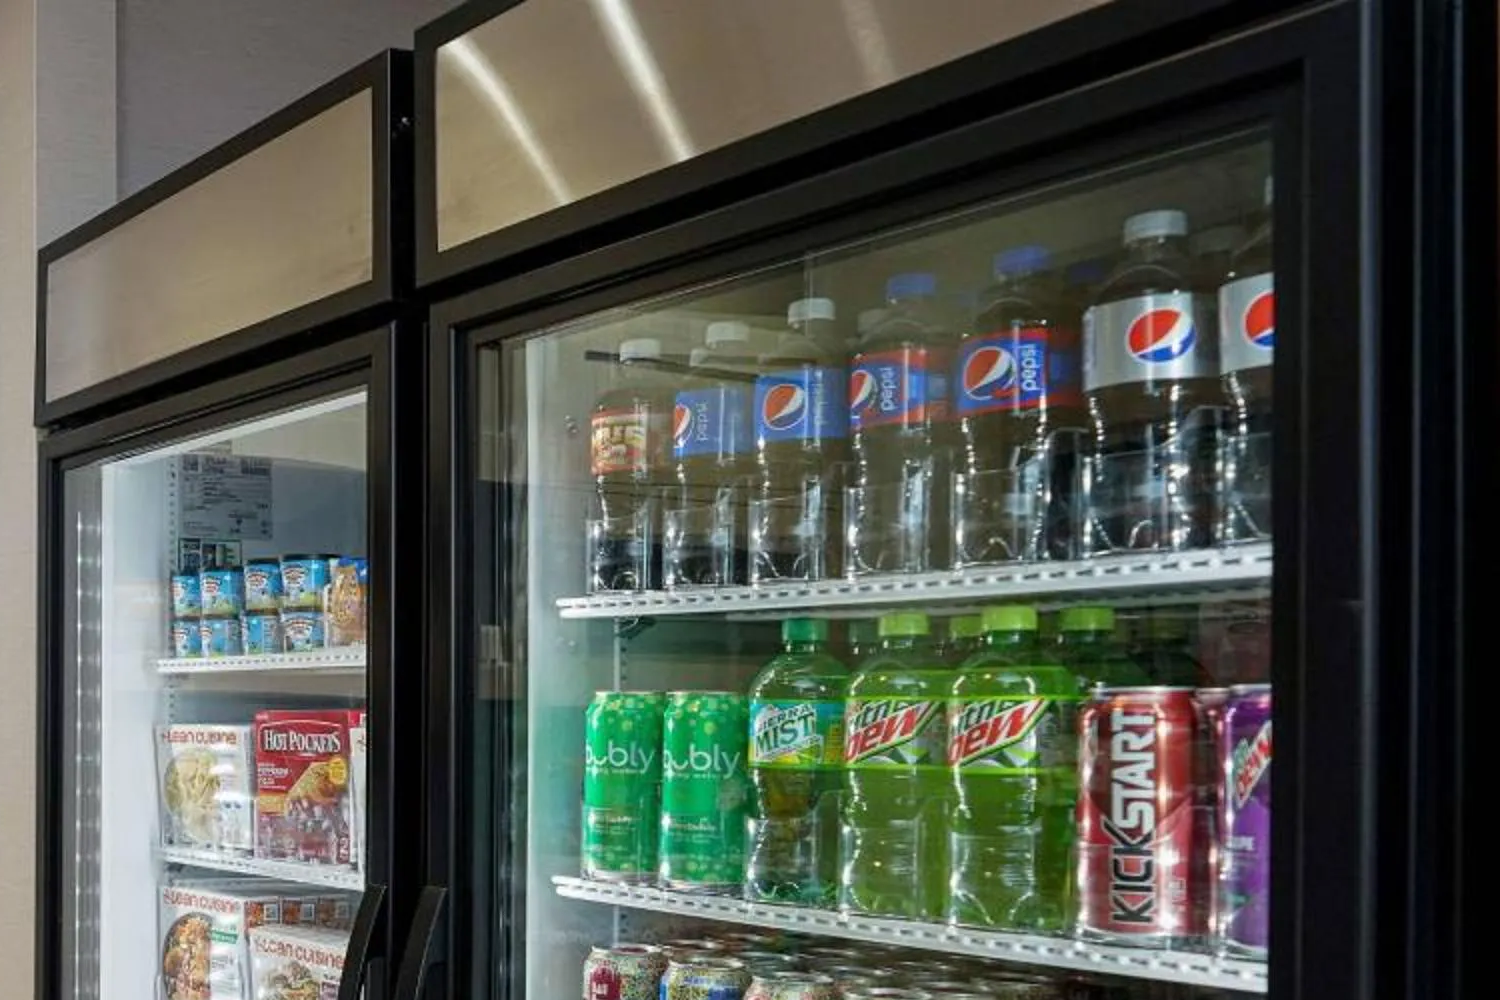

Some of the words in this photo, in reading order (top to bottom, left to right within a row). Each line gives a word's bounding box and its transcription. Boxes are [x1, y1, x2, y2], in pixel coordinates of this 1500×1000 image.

[880, 367, 897, 411] pepsi
[1020, 343, 1038, 391] pepsi
[264, 730, 287, 751] HOT
[289, 731, 341, 753] POCKETS
[755, 713, 815, 754] MIST
[1101, 710, 1156, 923] KICKSTART
